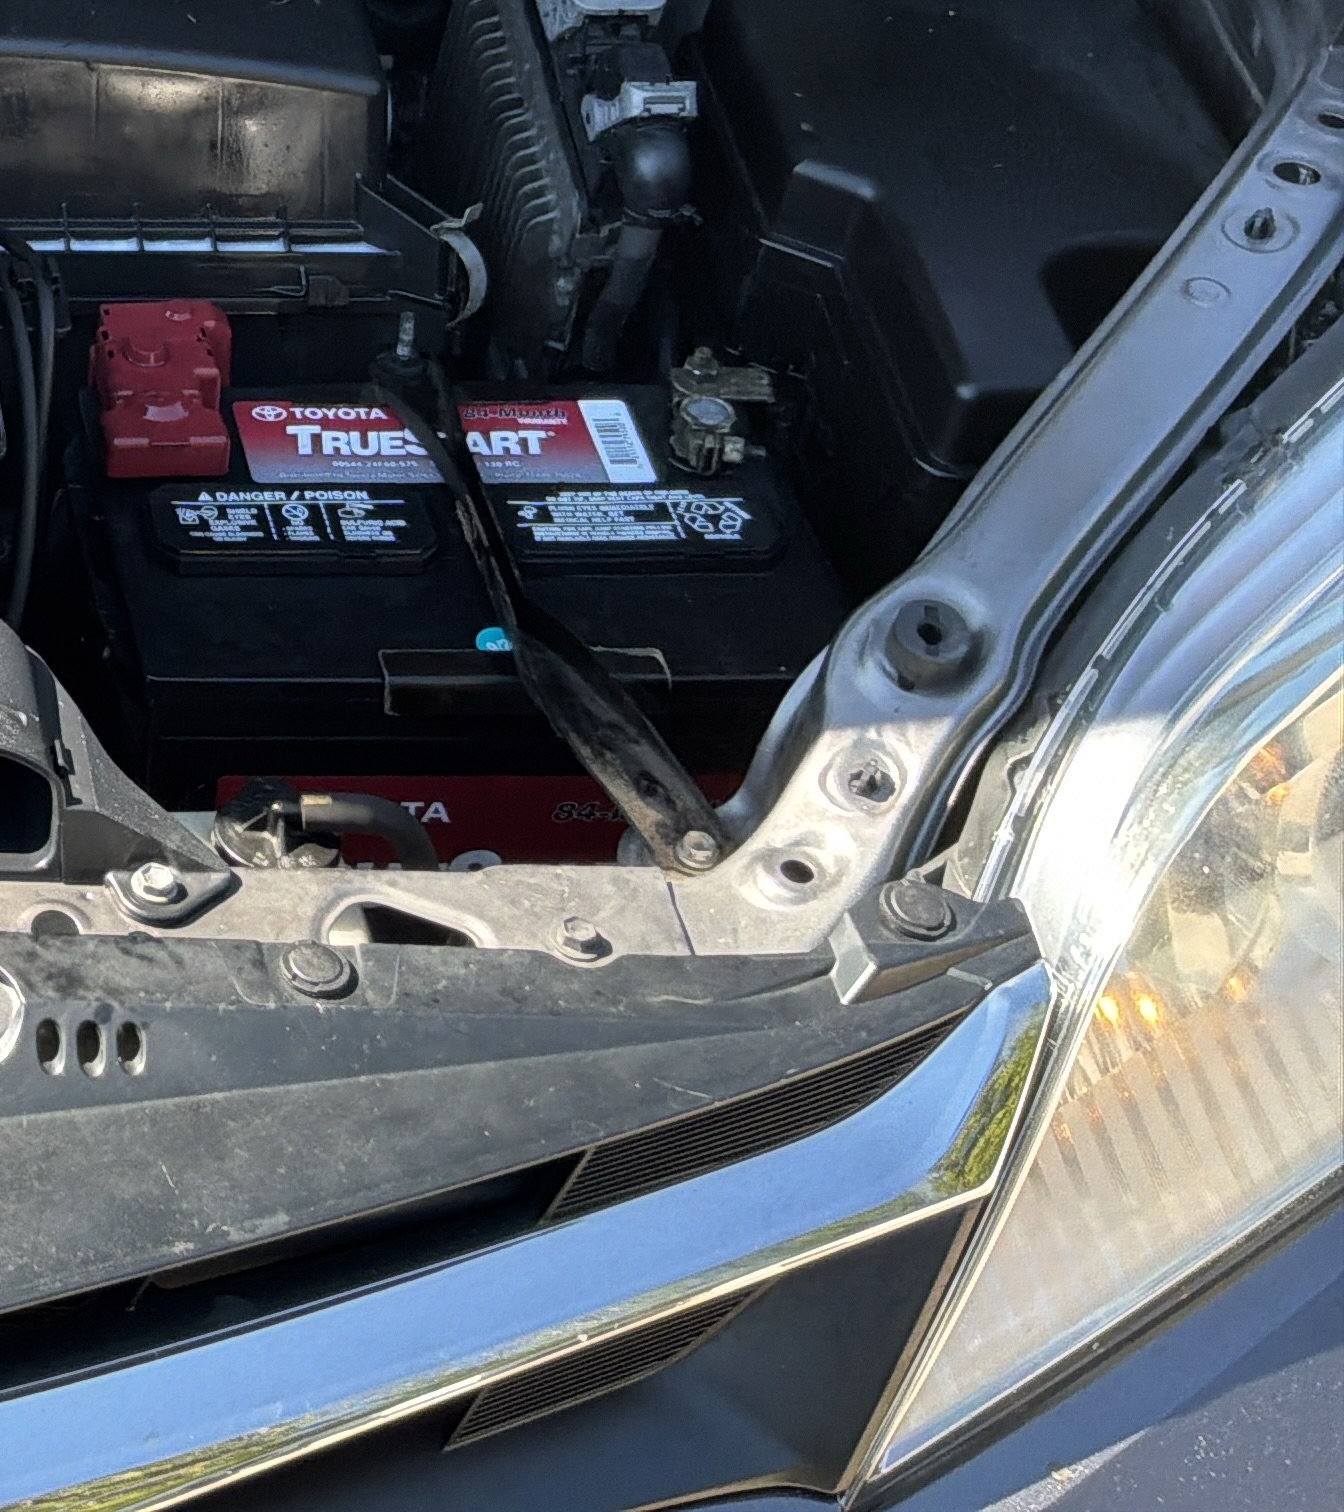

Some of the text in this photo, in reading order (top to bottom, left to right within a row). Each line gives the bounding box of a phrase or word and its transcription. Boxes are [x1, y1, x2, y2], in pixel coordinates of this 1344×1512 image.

[288, 407, 389, 420] TOYOTA
[215, 491, 287, 502] DANGER
[303, 490, 370, 500] POISON
